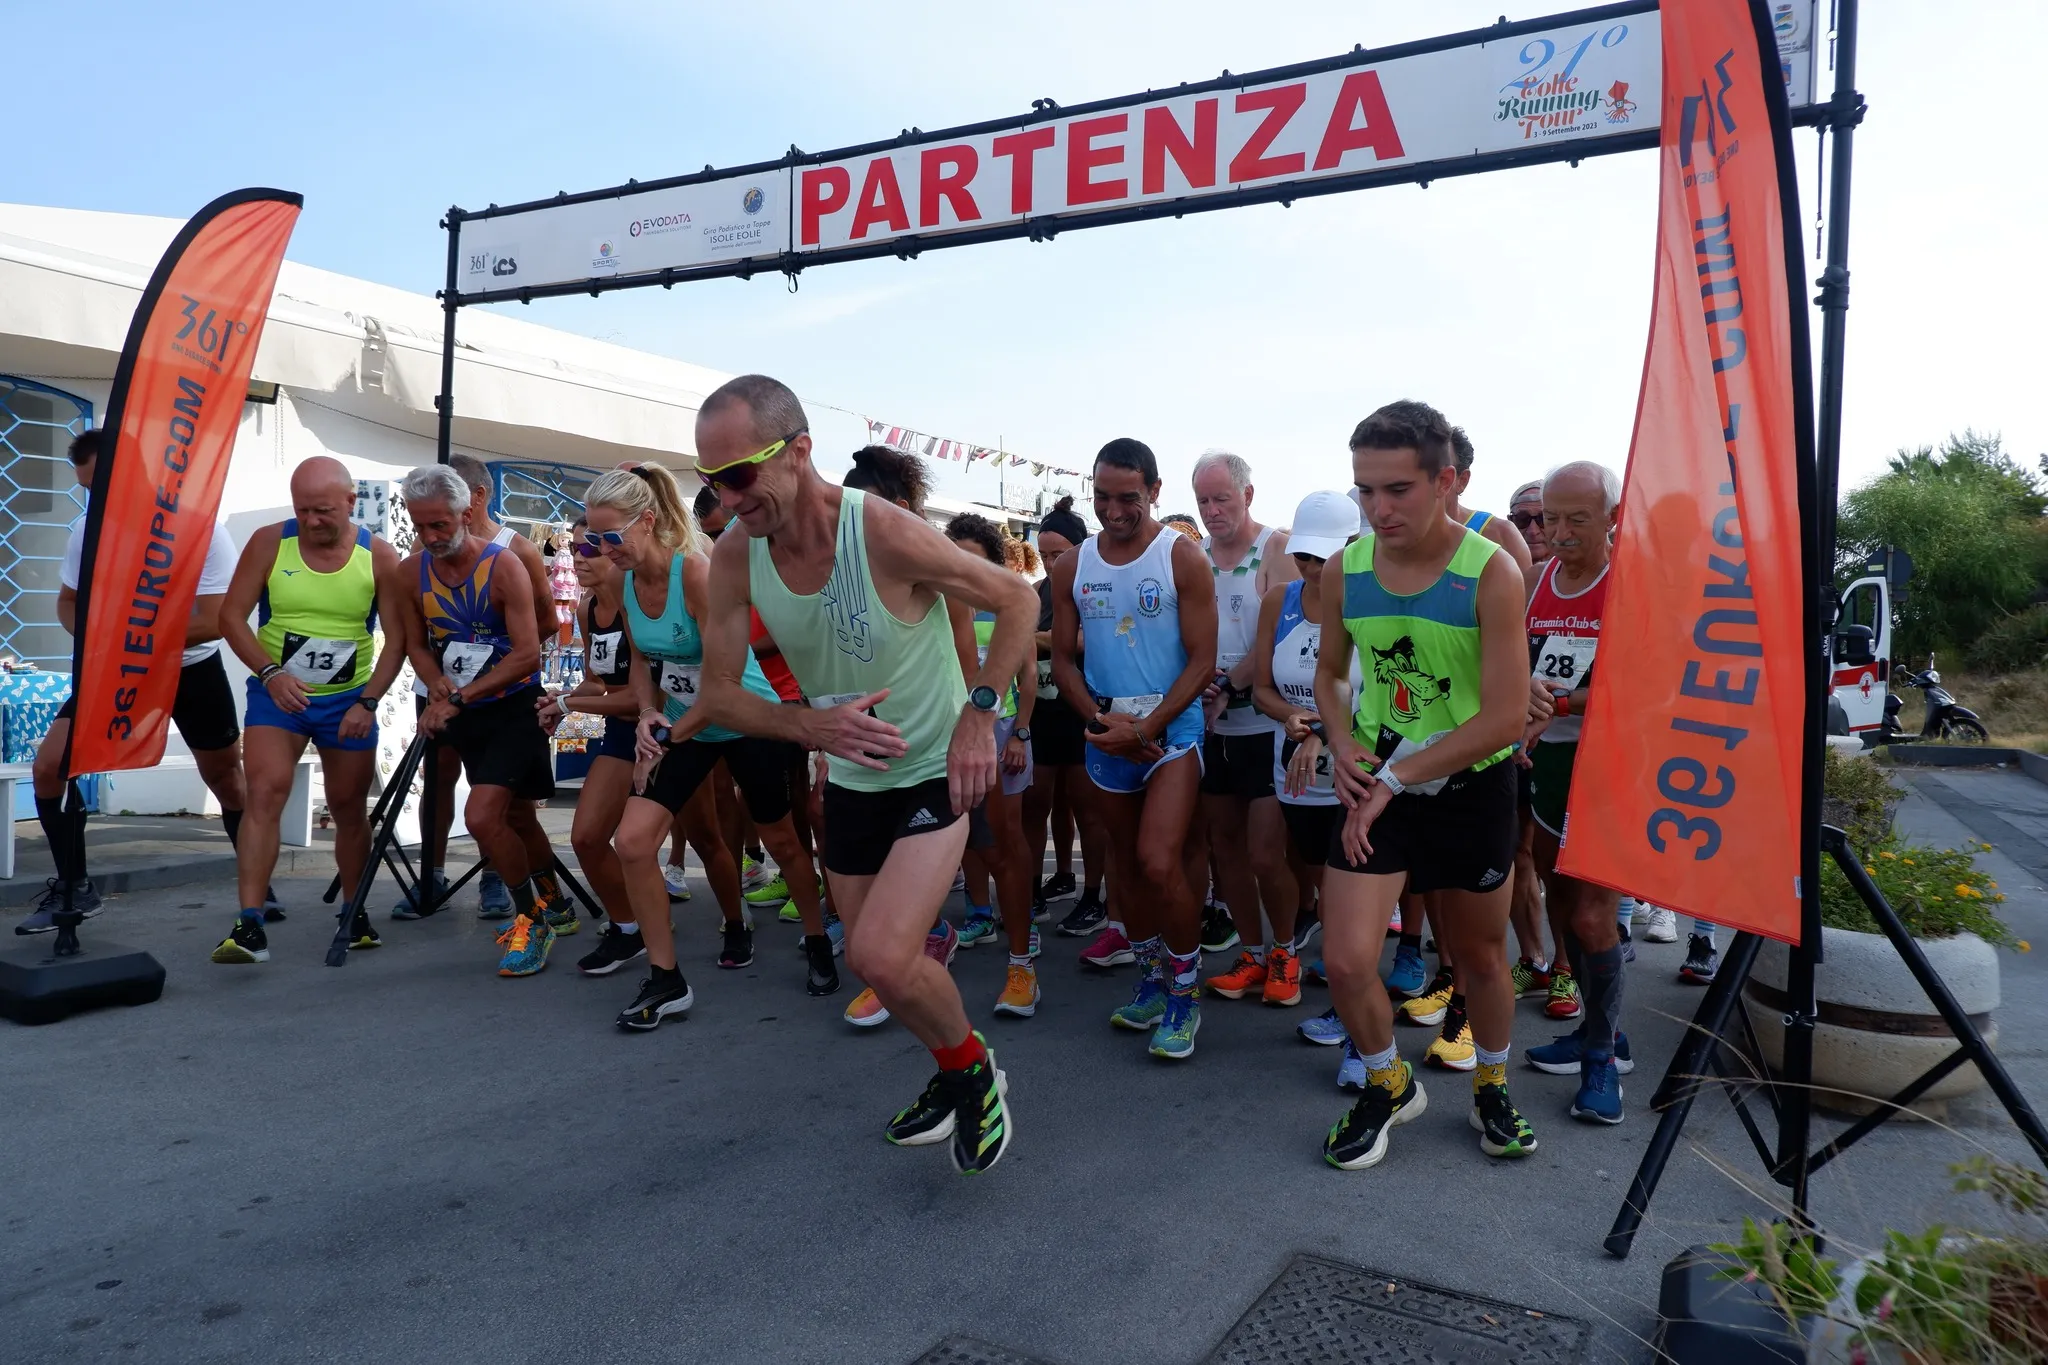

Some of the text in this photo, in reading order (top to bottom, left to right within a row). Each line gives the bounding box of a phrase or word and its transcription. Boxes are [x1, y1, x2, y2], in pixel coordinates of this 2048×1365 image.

[1493, 89, 1601, 122] Running
[1517, 107, 1584, 140] Tour
[1547, 124, 1581, 136] Settembre
[1582, 121, 1598, 131] 2023
[800, 70, 1406, 246] PARTENZA
[643, 213, 692, 230] EVODATA
[703, 226, 717, 236] Giro
[718, 223, 746, 234] Podistico
[710, 229, 761, 244] ISOLE EOLIE
[175, 293, 249, 362] 361°
[107, 374, 207, 742] 361EUROPE.COM
[1565, 615, 1590, 629] Club
[305, 651, 334, 671] 13
[452, 656, 464, 674] 4
[1544, 653, 1575, 679] 28
[667, 674, 695, 694] 33
[908, 817, 939, 828] adidas
[1478, 872, 1504, 888] adidas
